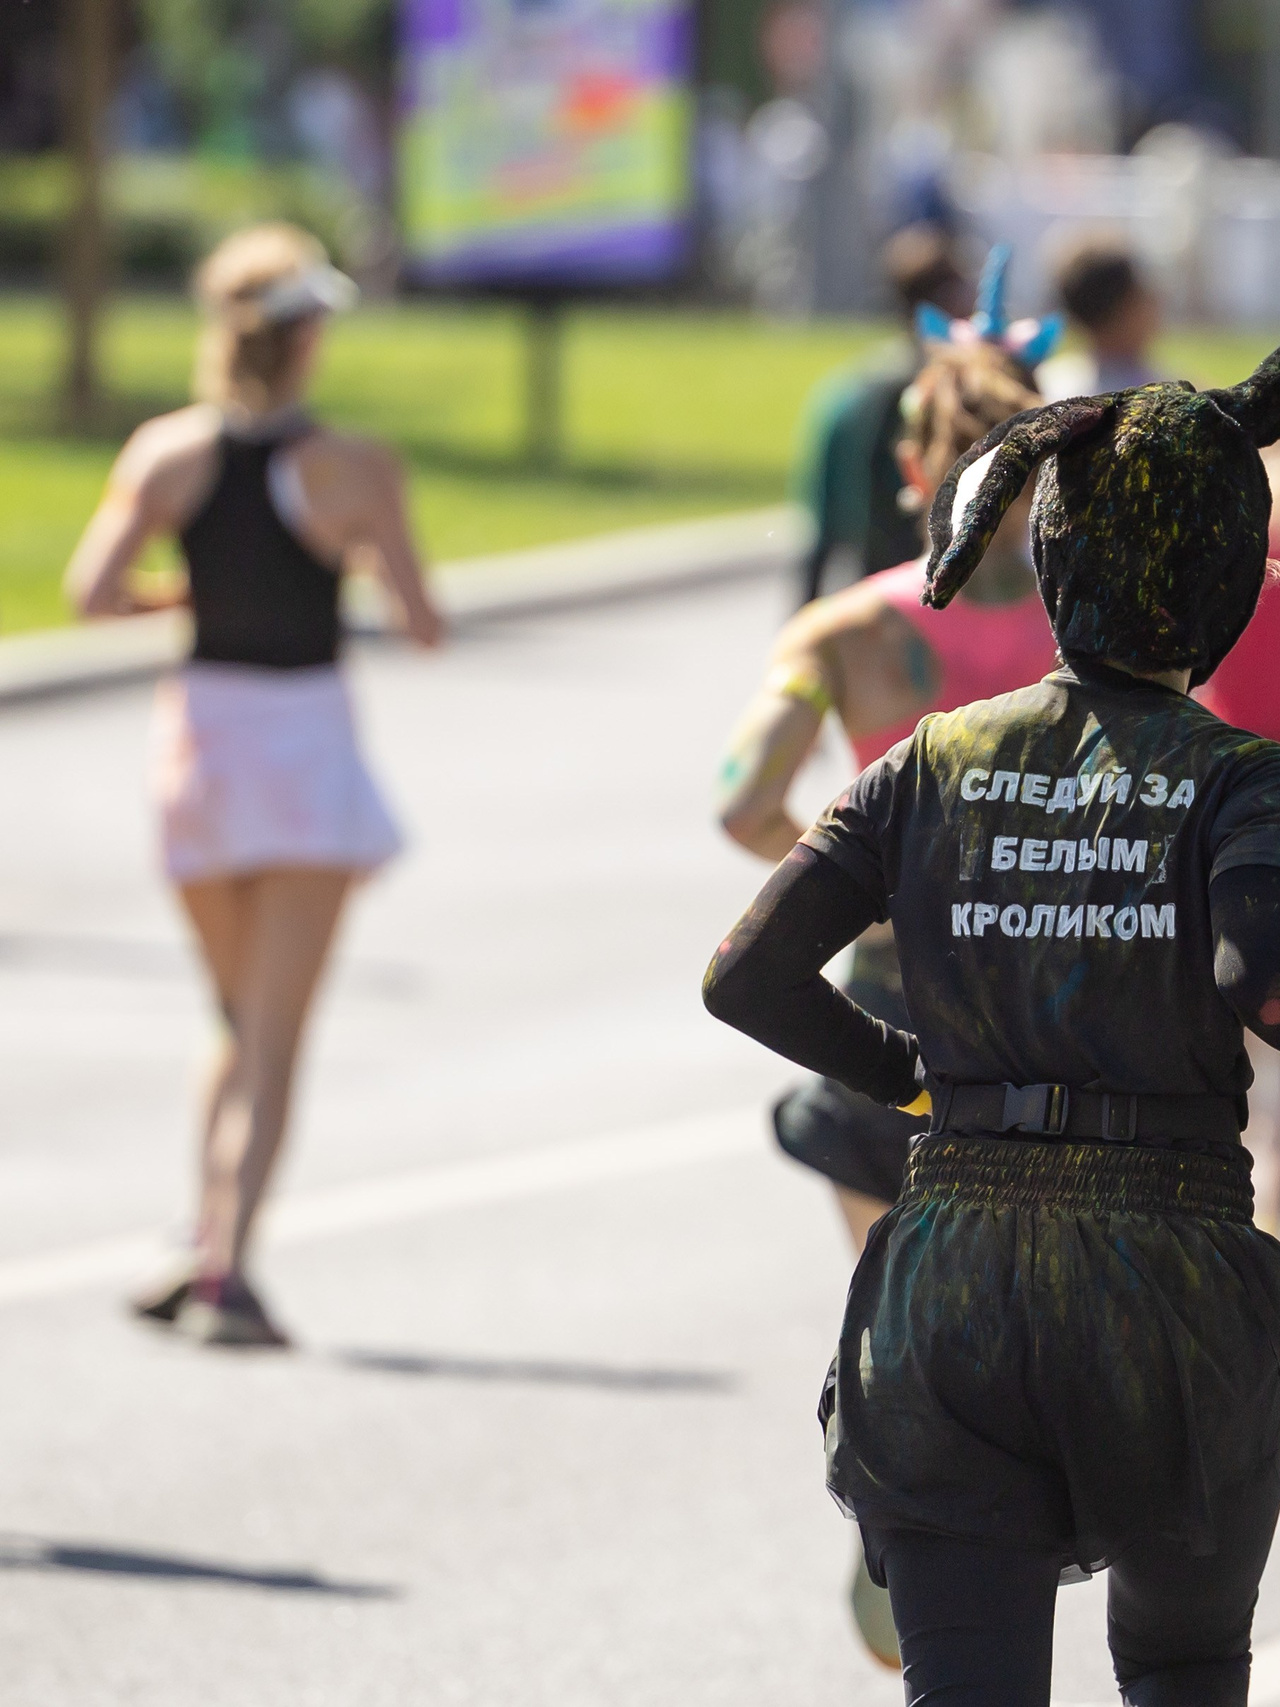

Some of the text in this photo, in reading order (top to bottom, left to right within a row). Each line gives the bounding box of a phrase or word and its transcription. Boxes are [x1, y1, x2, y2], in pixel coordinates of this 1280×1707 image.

[960, 766, 1195, 814] СЛЕДУЙ ЗА
[990, 835, 1149, 873] БЕЛЫМ
[950, 901, 1177, 941] КРОЛИКОМ
